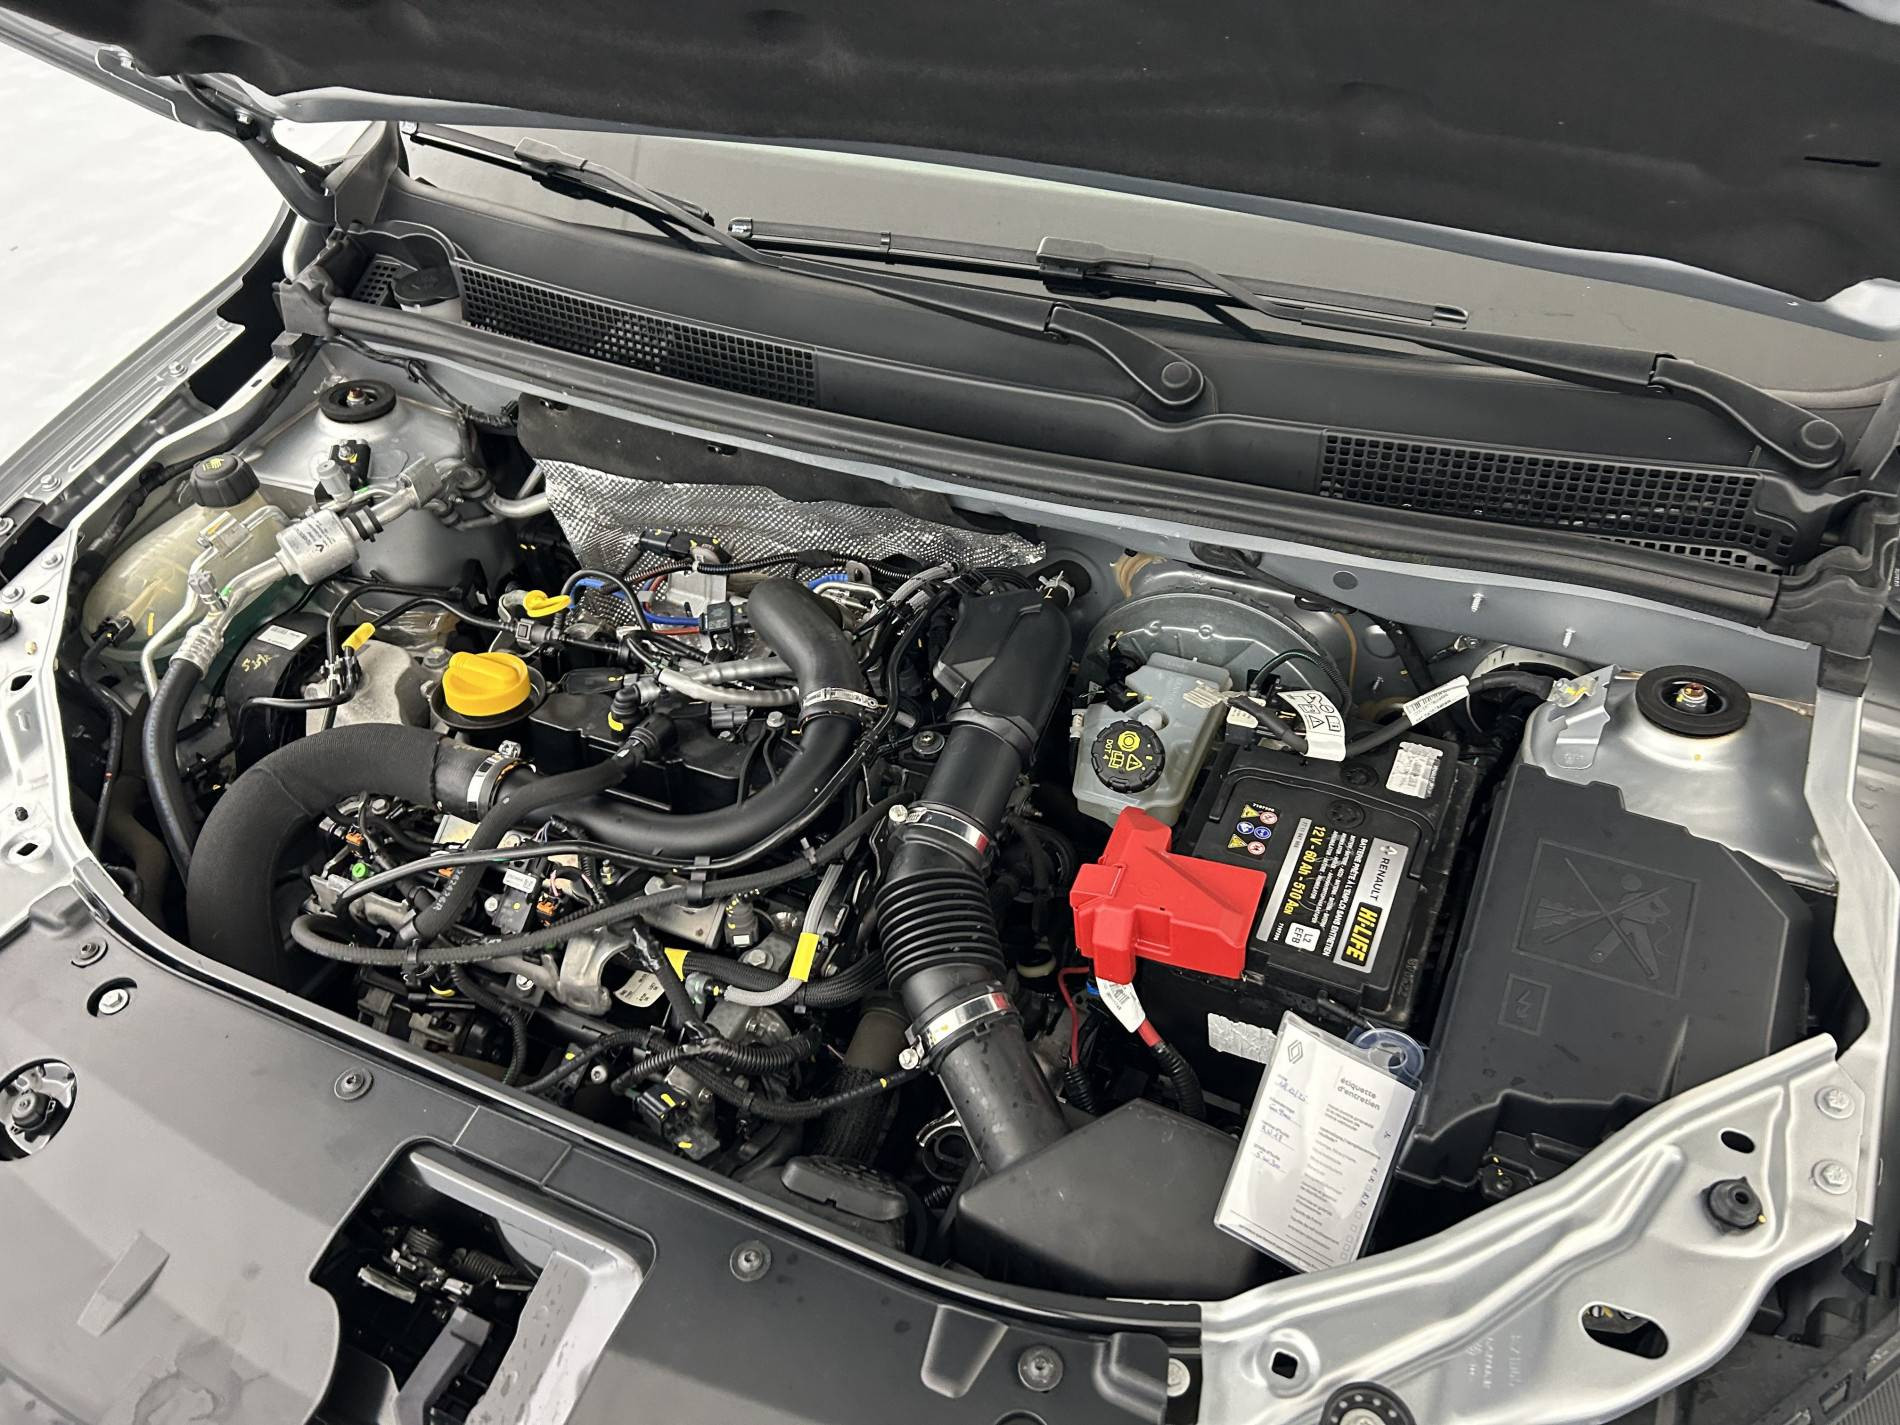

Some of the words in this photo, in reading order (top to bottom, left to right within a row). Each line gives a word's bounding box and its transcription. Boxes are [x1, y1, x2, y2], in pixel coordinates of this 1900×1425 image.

[1104, 738, 1114, 755] DOT
[1312, 824, 1326, 837] 12
[1309, 836, 1322, 845] V
[1302, 849, 1317, 863] 60
[1353, 837, 1368, 863] BATTERIE
[1298, 862, 1313, 876] Ah
[1369, 857, 1390, 901] RENAULT
[1288, 881, 1306, 900] 510
[1332, 909, 1343, 925] SANS
[1291, 927, 1303, 943] EFB
[1302, 932, 1313, 943] L2
[1322, 925, 1338, 956] ENTRETIEN
[1340, 1077, 1377, 1099] étiquette
[1337, 1085, 1381, 1111] d'entretien
